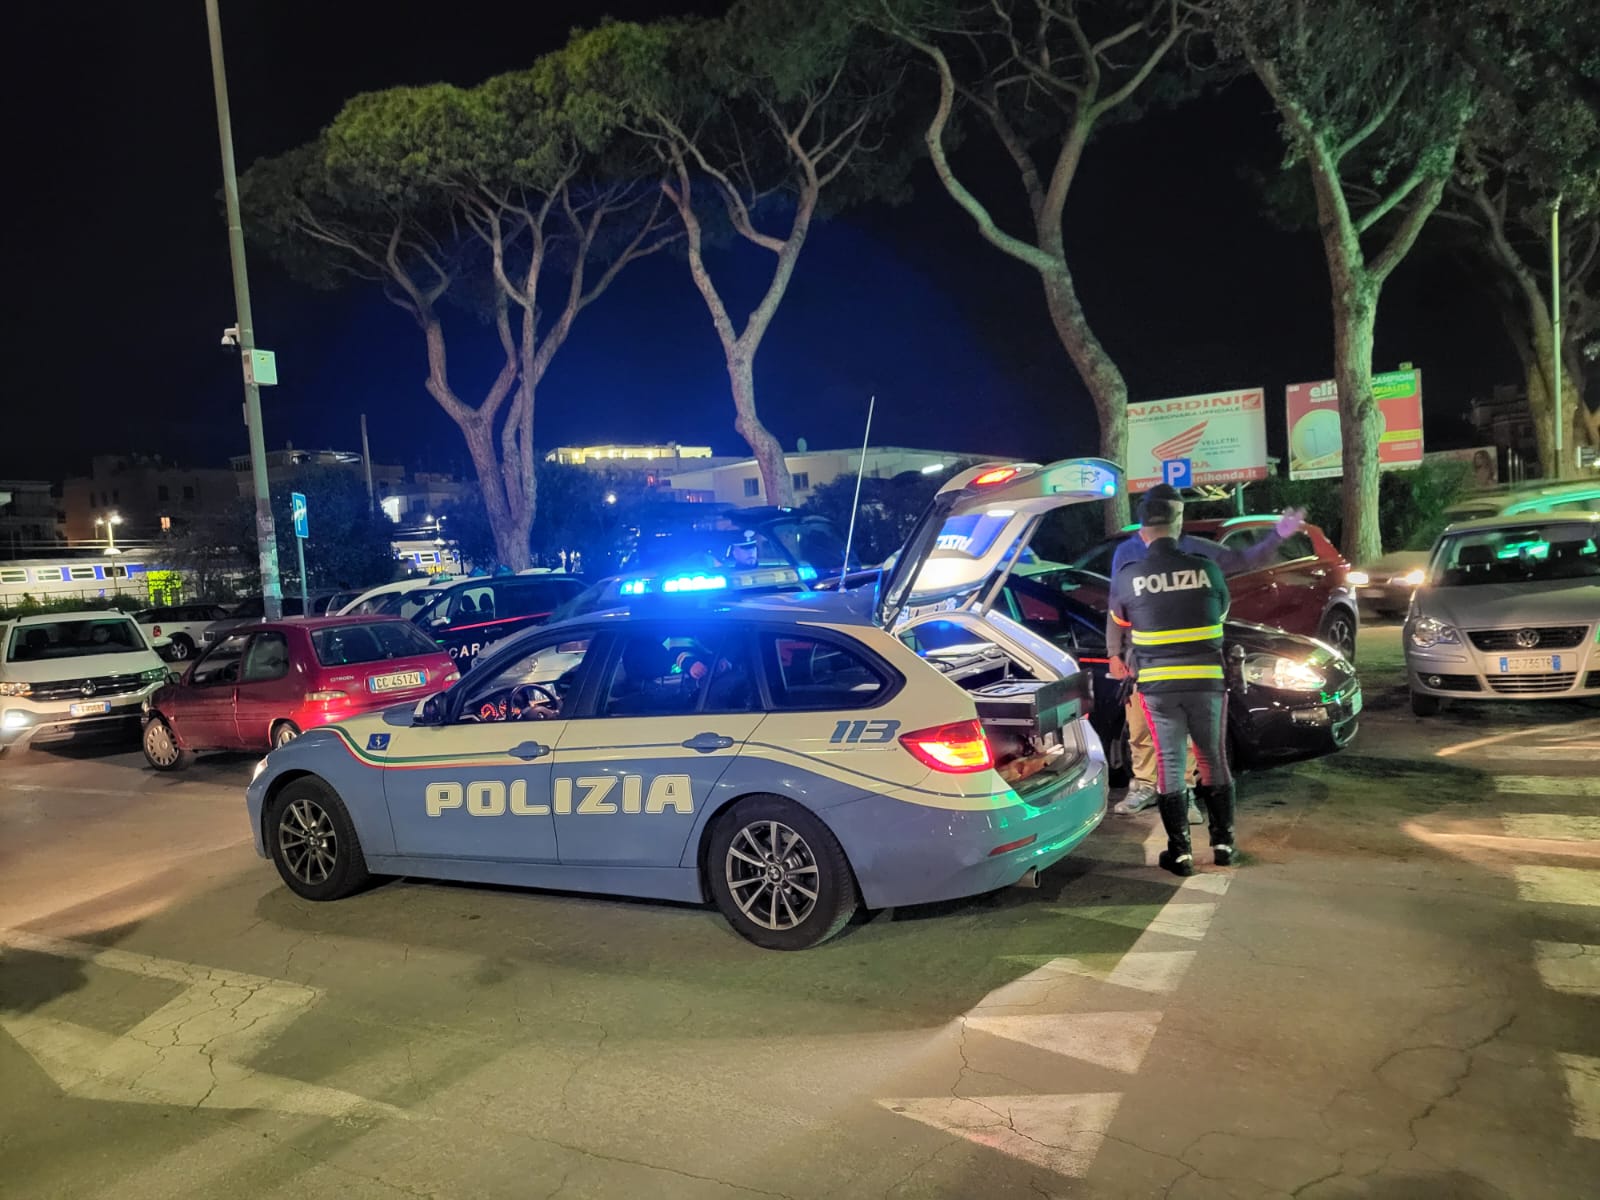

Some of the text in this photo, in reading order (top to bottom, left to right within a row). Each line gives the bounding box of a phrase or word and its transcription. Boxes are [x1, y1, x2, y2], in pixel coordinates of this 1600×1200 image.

[1127, 396, 1240, 416] NARDINI
[1152, 461, 1211, 473] HDA
[1167, 462, 1185, 486] P
[1132, 569, 1212, 597] POLIZIA
[829, 720, 901, 743] 113
[425, 774, 695, 817] POLIZIA
